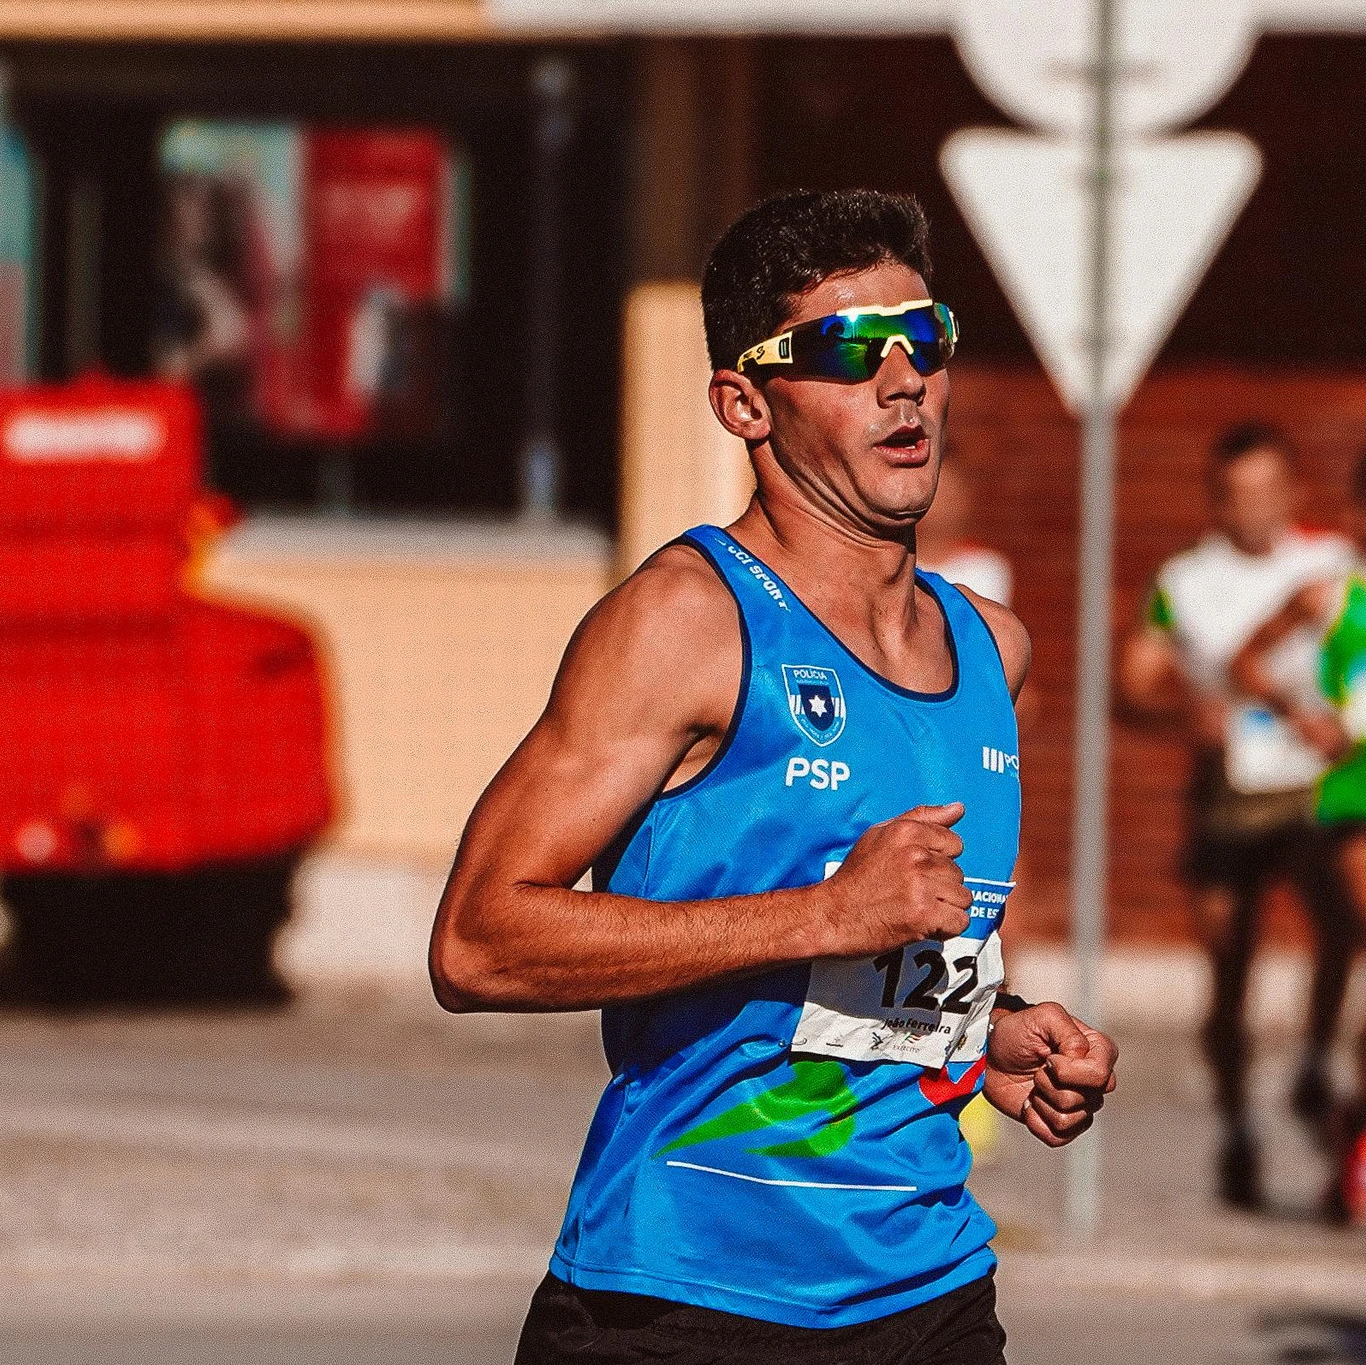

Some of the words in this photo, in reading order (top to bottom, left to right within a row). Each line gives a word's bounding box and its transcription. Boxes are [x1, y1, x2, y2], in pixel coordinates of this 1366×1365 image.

[785, 757, 851, 791] PSP
[970, 905, 985, 918] DE
[872, 946, 978, 1015] 122
